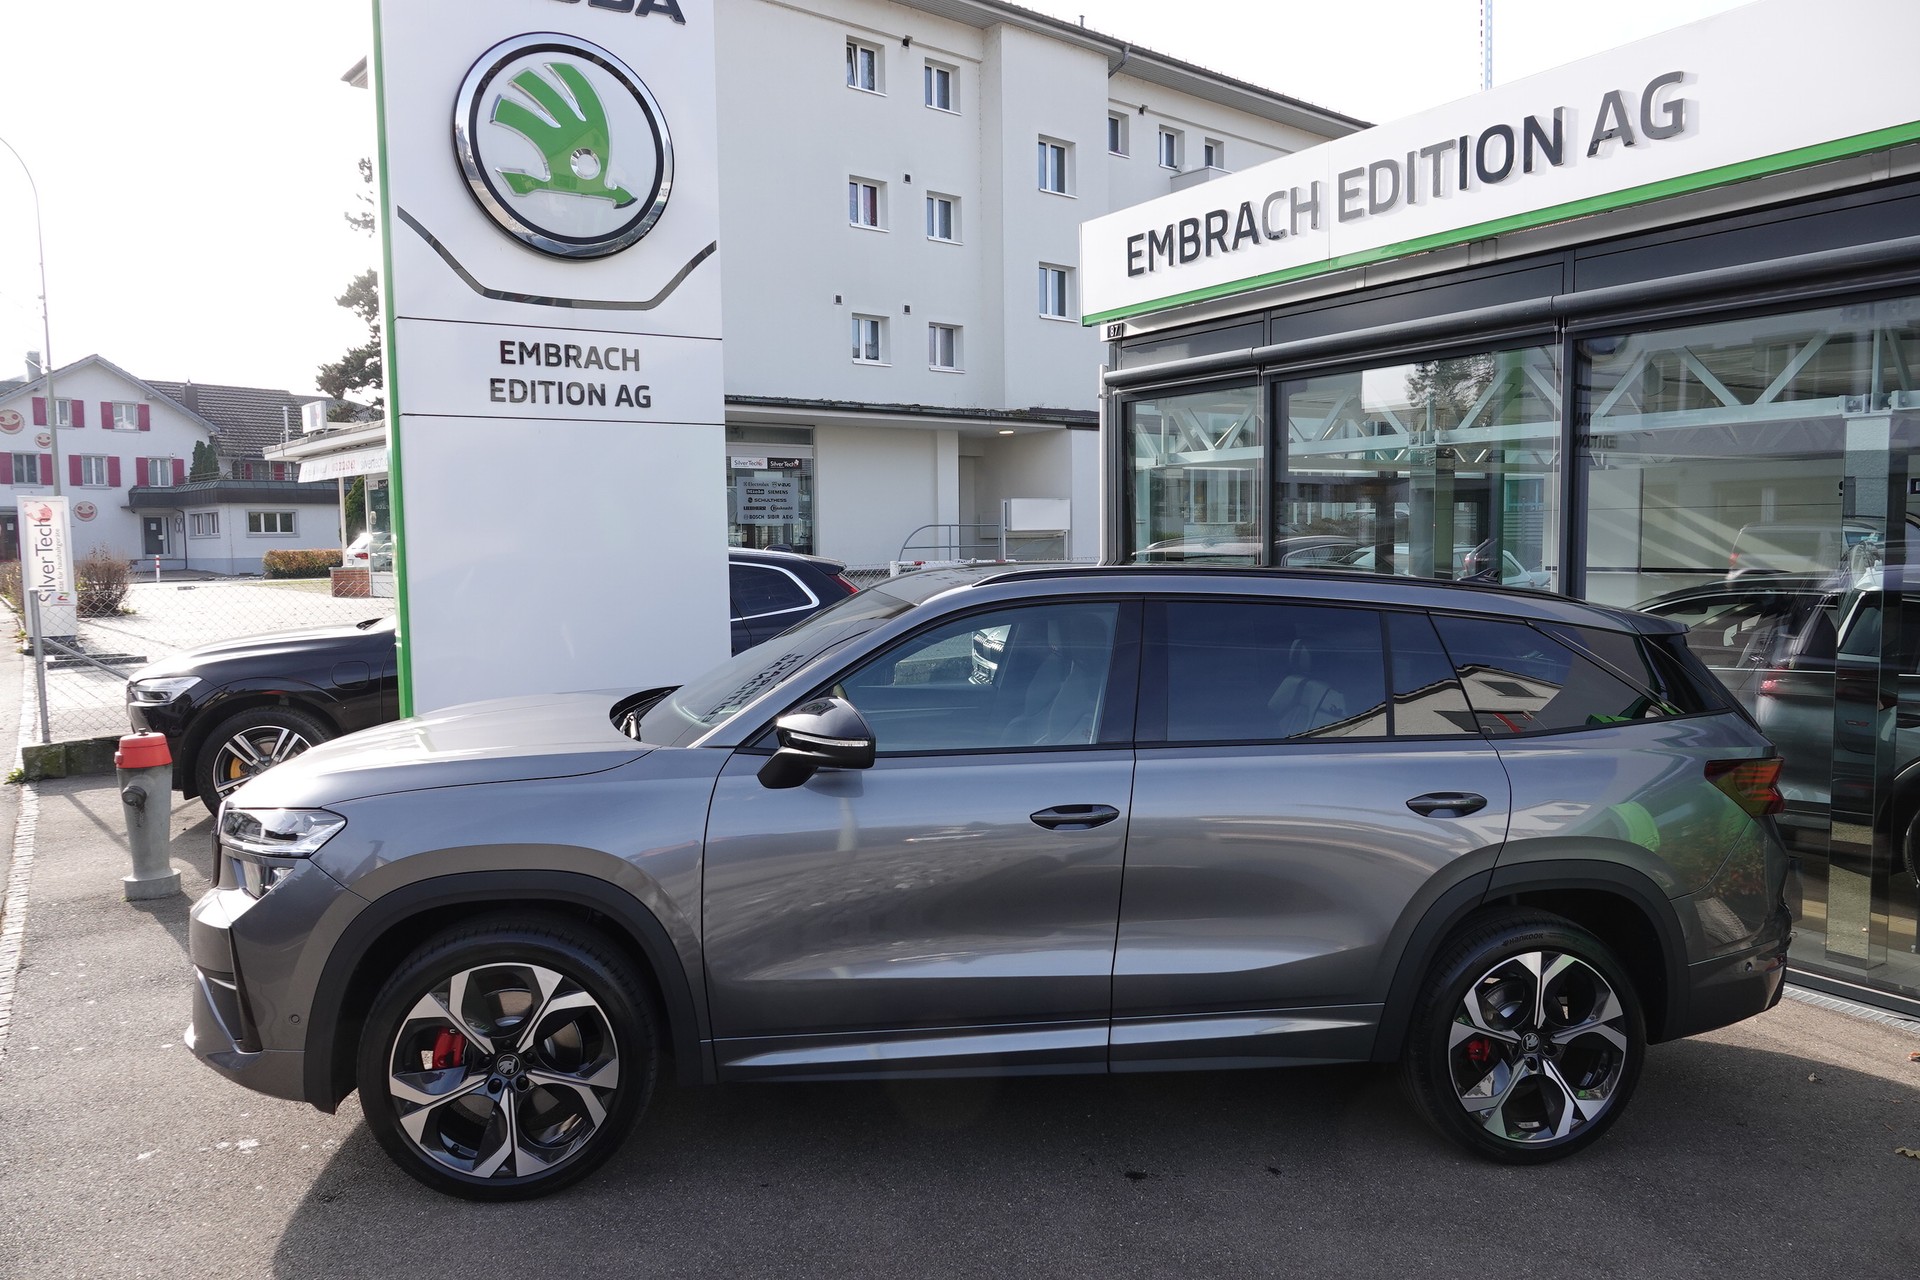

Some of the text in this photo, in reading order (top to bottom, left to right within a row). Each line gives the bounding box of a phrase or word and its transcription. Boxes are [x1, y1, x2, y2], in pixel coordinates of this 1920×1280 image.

[1126, 70, 1687, 278] EMBRACH EDITION AG
[1109, 325, 1119, 337] 87
[499, 340, 640, 372] EMBRACH
[489, 377, 652, 409] EDITION AG
